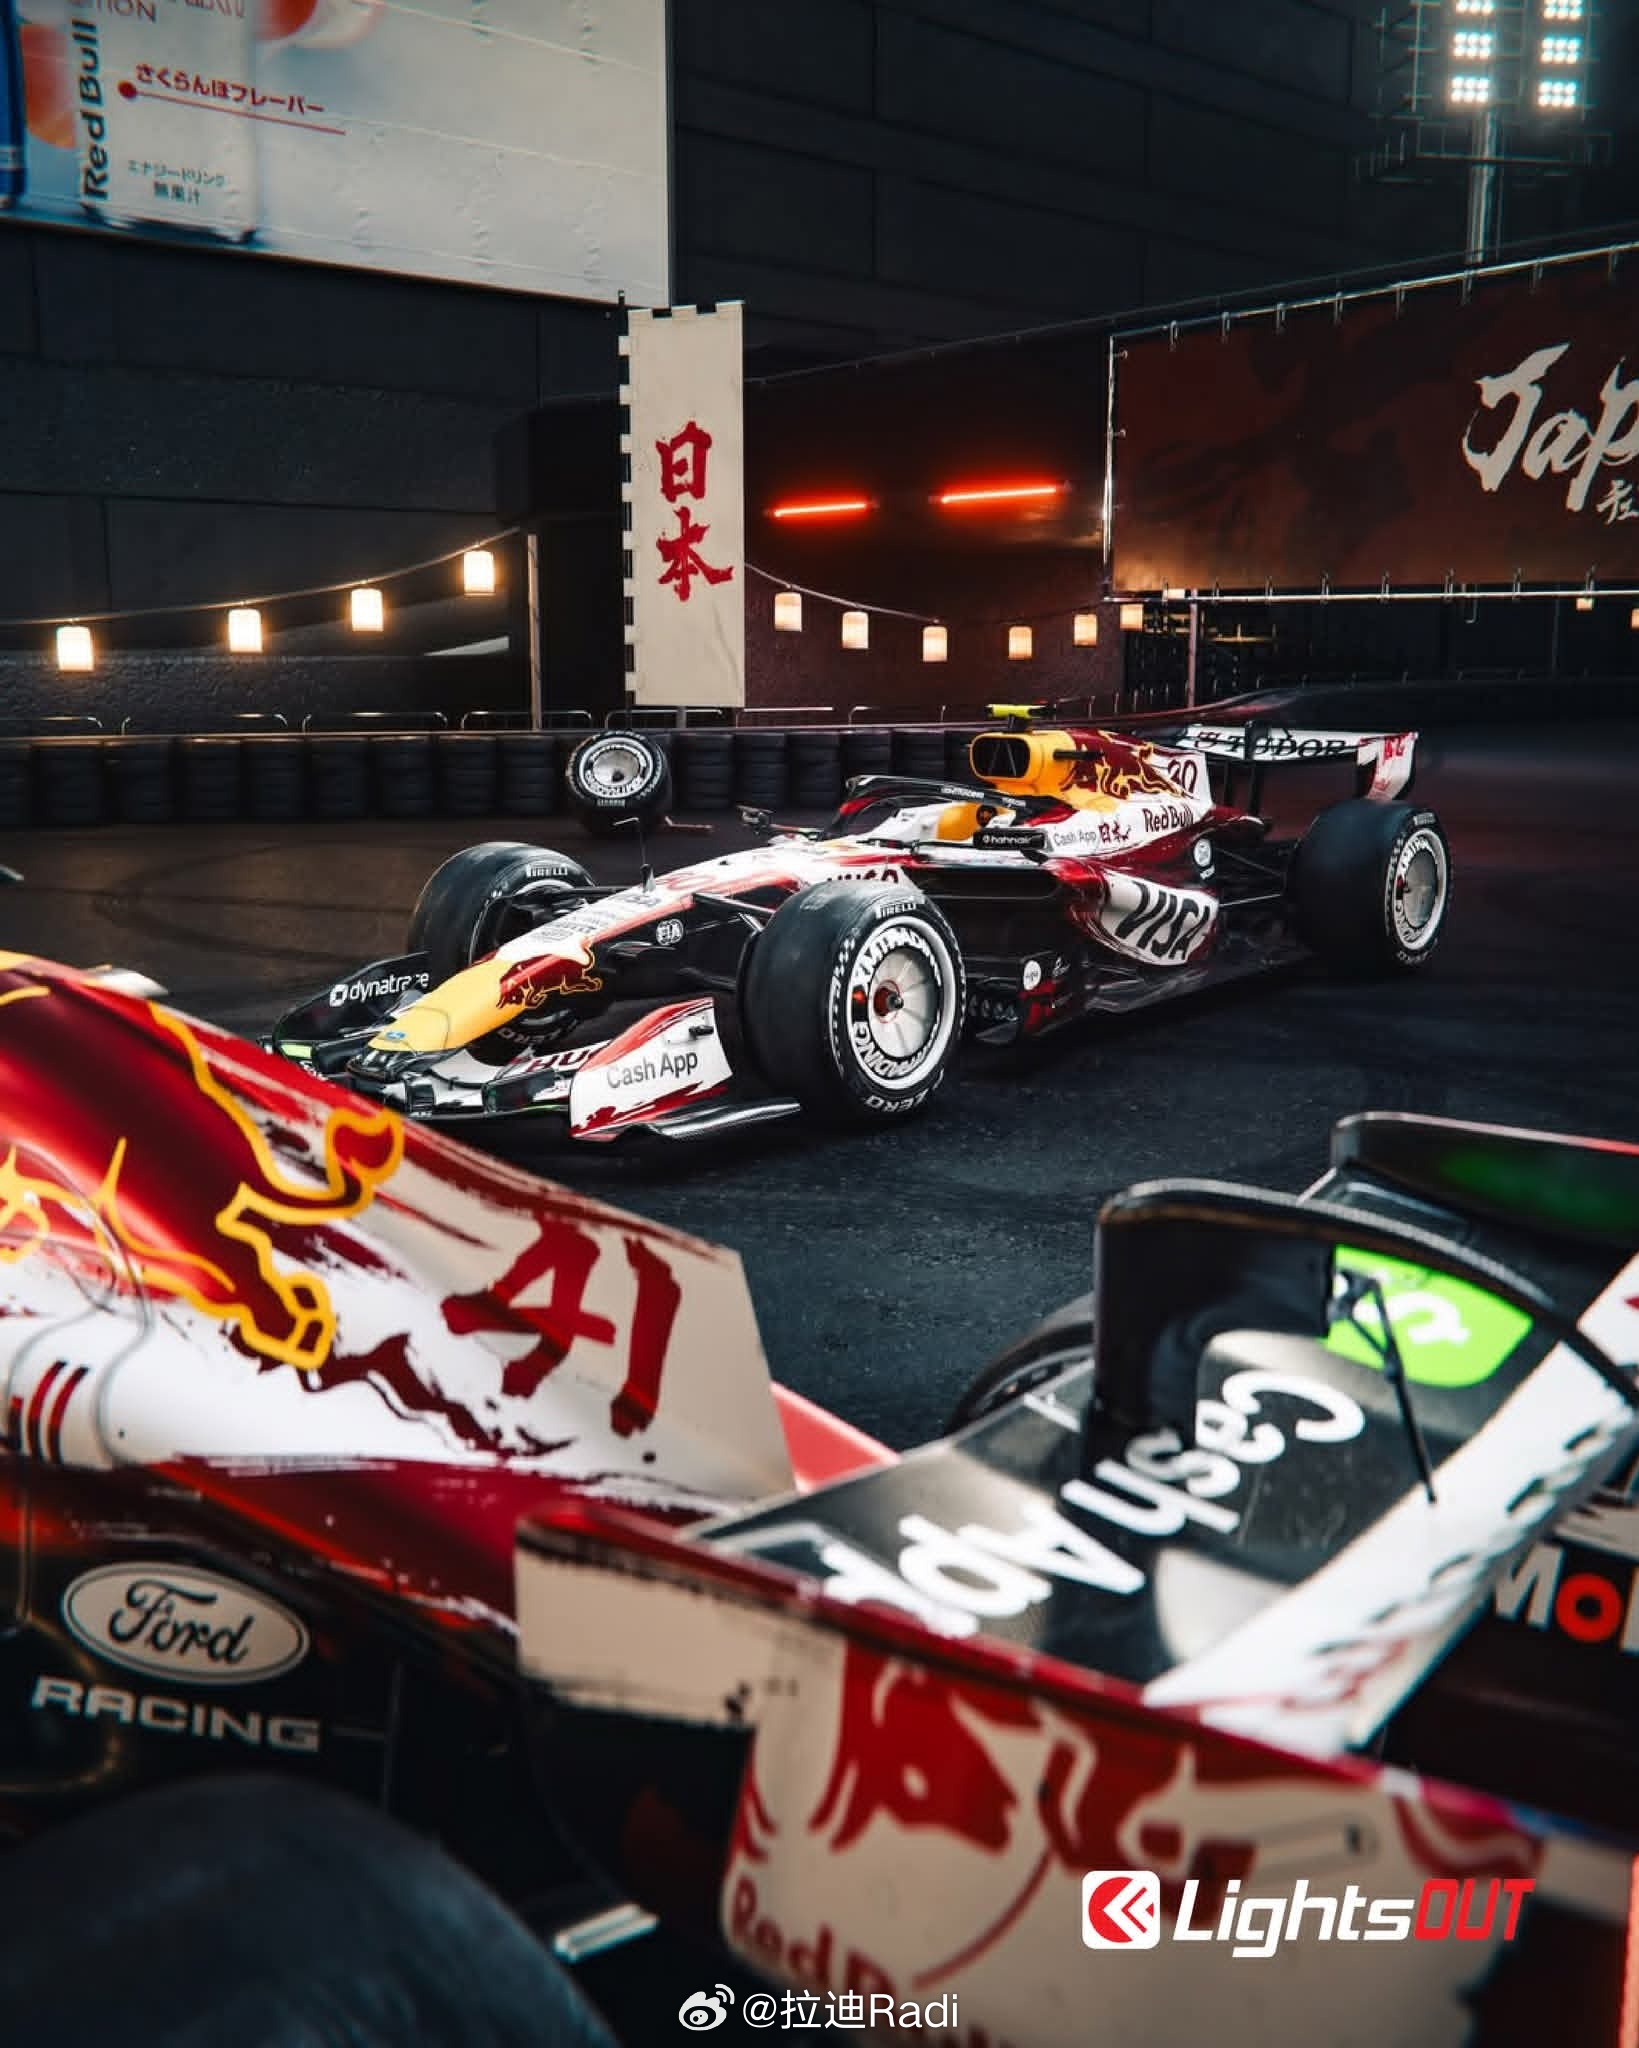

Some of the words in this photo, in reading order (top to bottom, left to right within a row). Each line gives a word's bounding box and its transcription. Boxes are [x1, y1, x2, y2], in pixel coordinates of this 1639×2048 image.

[71, 17, 101, 106] Bull
[79, 110, 108, 200] Red
[655, 420, 734, 602] 日本
[1142, 804, 1169, 832] Red
[1167, 801, 1194, 829] Bull
[1114, 879, 1211, 961] VISA
[606, 1060, 657, 1089] Cash
[659, 1050, 698, 1078] App
[1060, 1369, 1366, 1535] Cash
[109, 1577, 256, 1665] Ford
[31, 1673, 323, 1753] RACING
